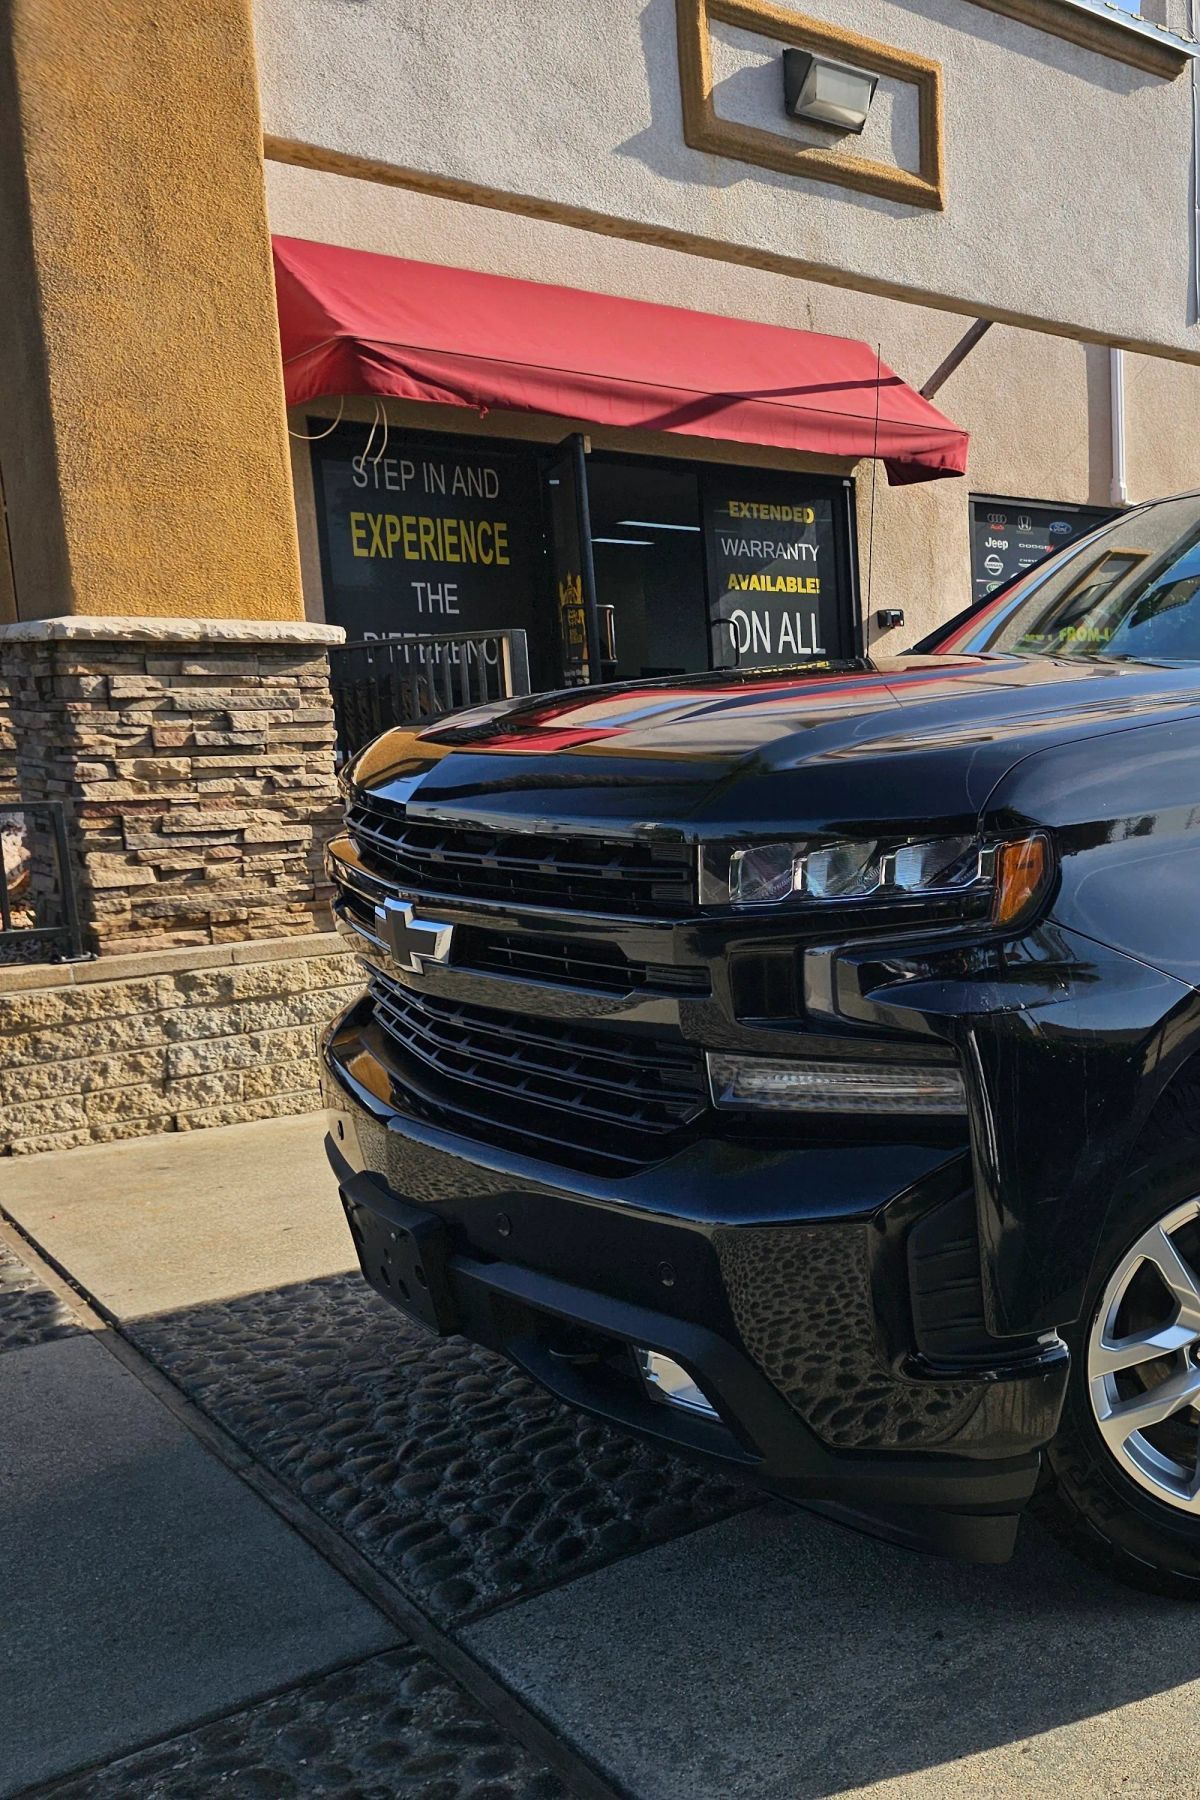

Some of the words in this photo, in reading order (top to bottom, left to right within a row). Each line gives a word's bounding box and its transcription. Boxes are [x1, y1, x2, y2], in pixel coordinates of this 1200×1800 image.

[352, 455, 416, 492] STEP
[422, 461, 447, 495] IN
[451, 465, 500, 499] AND
[728, 501, 816, 524] EXTENDED
[350, 511, 511, 566] EXPERIENCE
[720, 537, 820, 562] WARRANTY
[985, 537, 1009, 551] Jeep
[410, 582, 460, 614] THE
[727, 573, 821, 595] AVAILABLE!
[729, 609, 772, 654] ON
[777, 611, 827, 655] ALL
